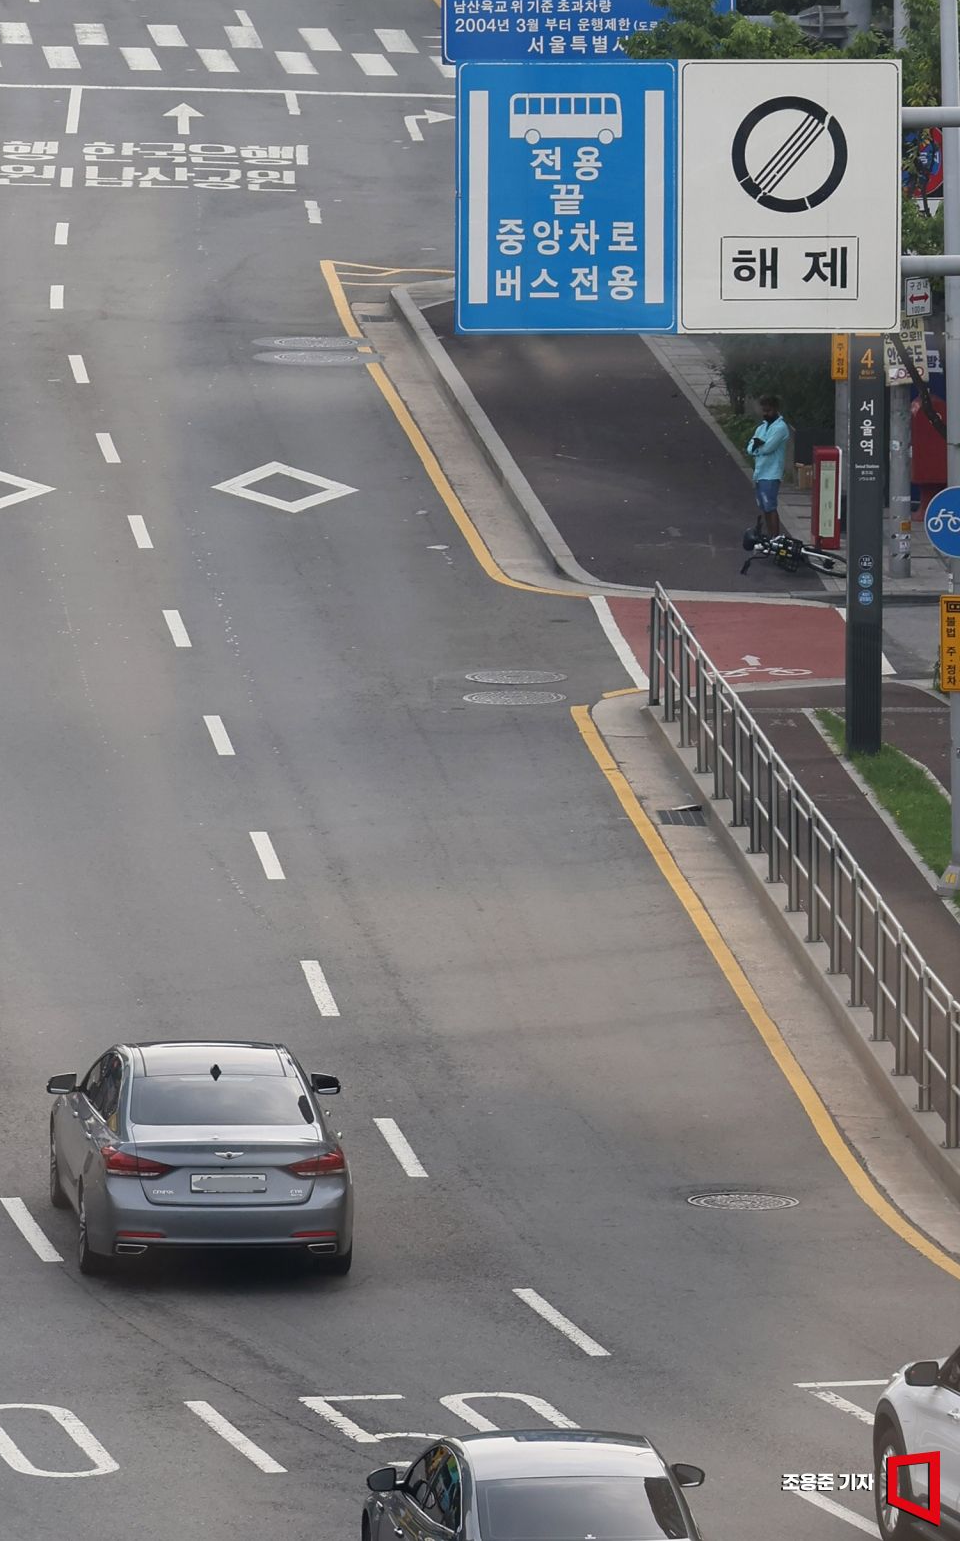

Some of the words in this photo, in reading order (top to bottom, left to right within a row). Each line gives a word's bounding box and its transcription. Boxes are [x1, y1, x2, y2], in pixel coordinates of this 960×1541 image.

[453, 0, 508, 14] 남산육교
[510, 0, 523, 14] 위
[527, 0, 554, 14] 기준
[557, 0, 612, 14] 초과차량
[455, 18, 510, 33] 2004년
[516, 18, 539, 32] 3월
[545, 18, 571, 32] 부터
[577, 18, 631, 32] 운행제한
[82, 141, 299, 165] 한국은행
[530, 146, 603, 181] 전용
[84, 166, 297, 193] 남산공원
[549, 184, 584, 215] 끝
[495, 219, 638, 255] 중앙차로
[495, 265, 638, 301] 버스전용
[731, 246, 849, 290] 해제
[860, 348, 875, 368] 4
[860, 399, 876, 456] 서울역
